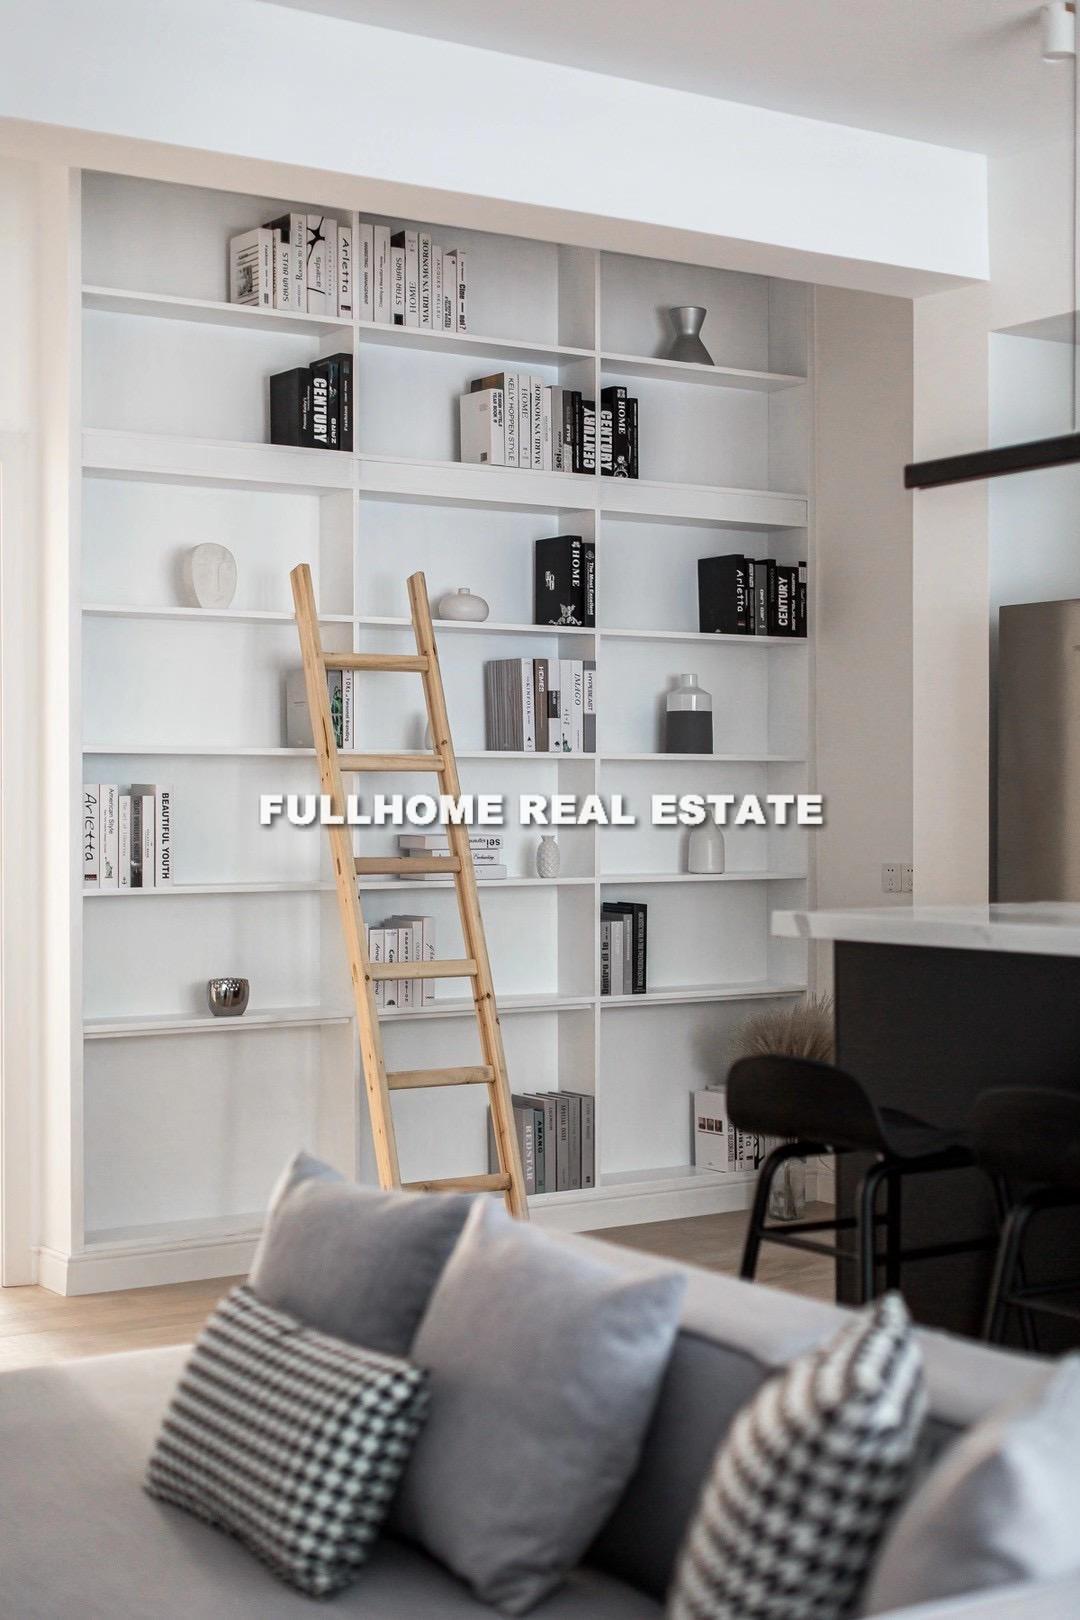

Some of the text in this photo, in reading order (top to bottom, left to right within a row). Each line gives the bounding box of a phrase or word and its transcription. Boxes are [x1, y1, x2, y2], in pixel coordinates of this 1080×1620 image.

[341, 237, 350, 293] Arletta
[313, 377, 328, 443] CENTURY
[521, 388, 529, 419] HOME
[618, 401, 626, 435] HOME
[582, 405, 595, 469] CENTURY
[601, 410, 612, 471] CENTURY
[571, 550, 580, 587] HOME
[736, 569, 744, 612] Arletta
[778, 576, 788, 626] CENTURY
[84, 792, 97, 862] Arletta
[161, 792, 169, 879] BEAUTIFUL YOUTH
